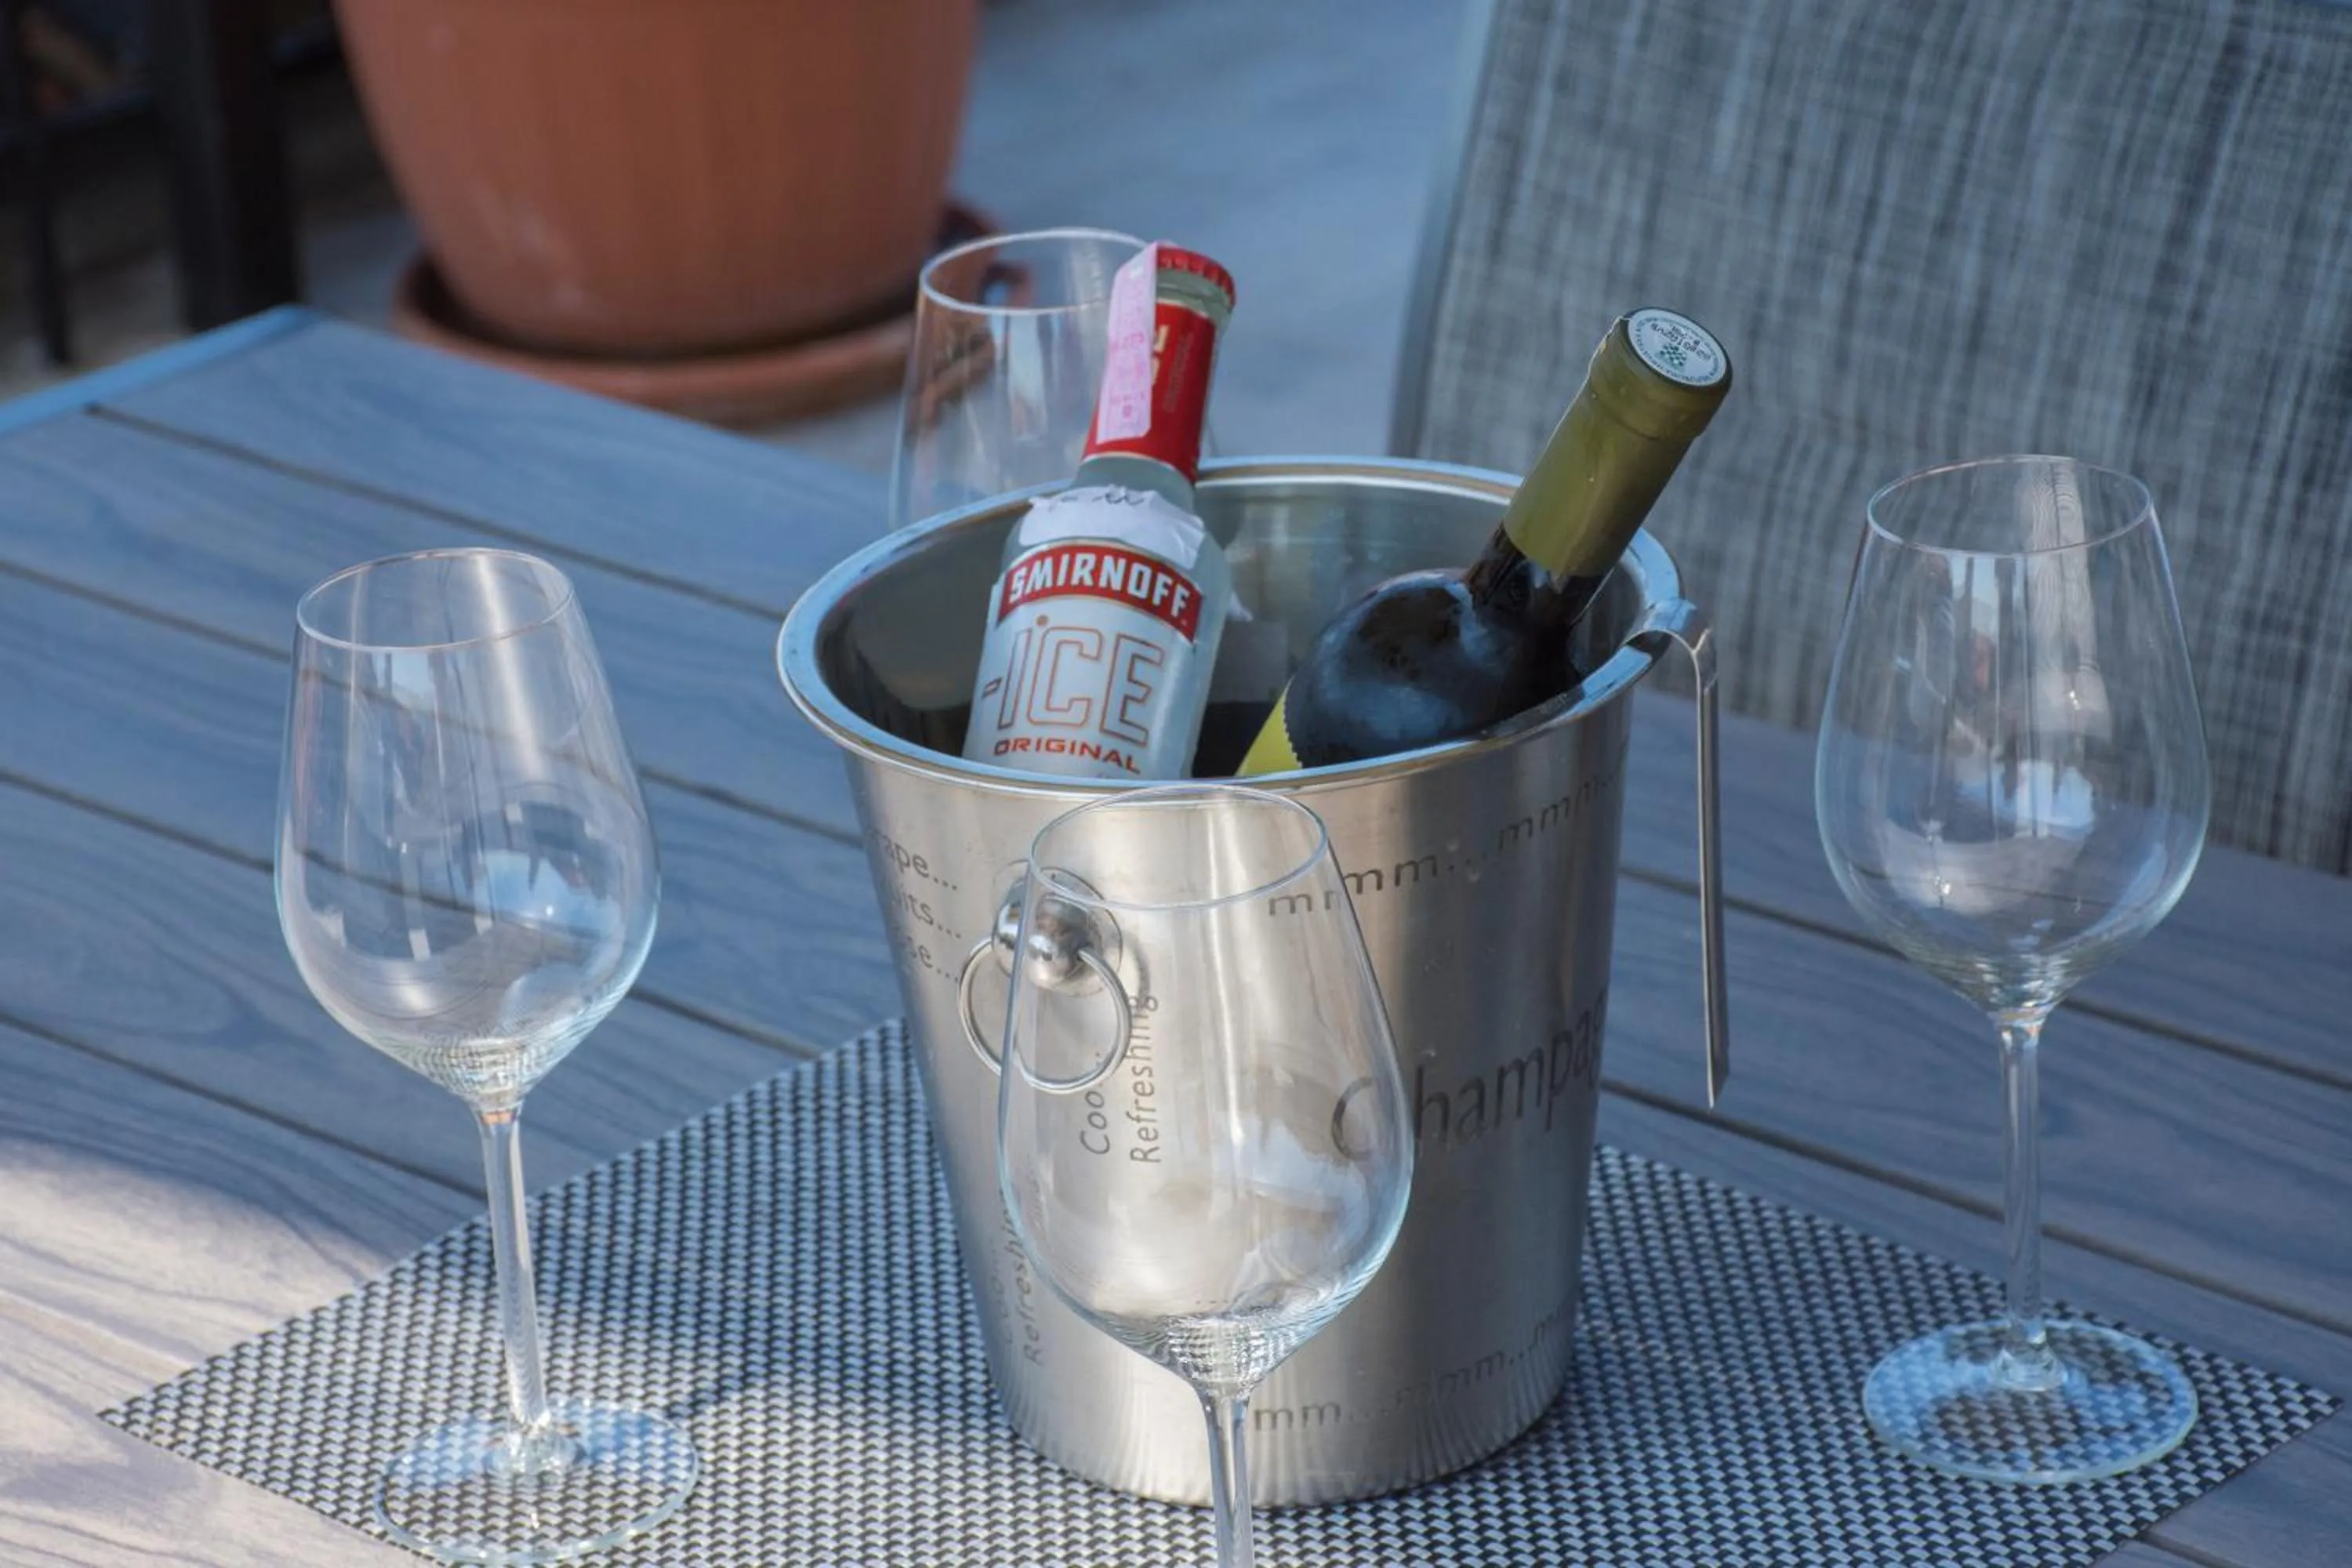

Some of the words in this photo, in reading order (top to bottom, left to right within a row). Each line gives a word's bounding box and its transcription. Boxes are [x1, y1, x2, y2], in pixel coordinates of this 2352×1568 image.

[1008, 552, 1190, 618] SMIRNOFF
[993, 737, 1141, 775] ORIGINAL
[1125, 995, 1162, 1163] Refreshing
